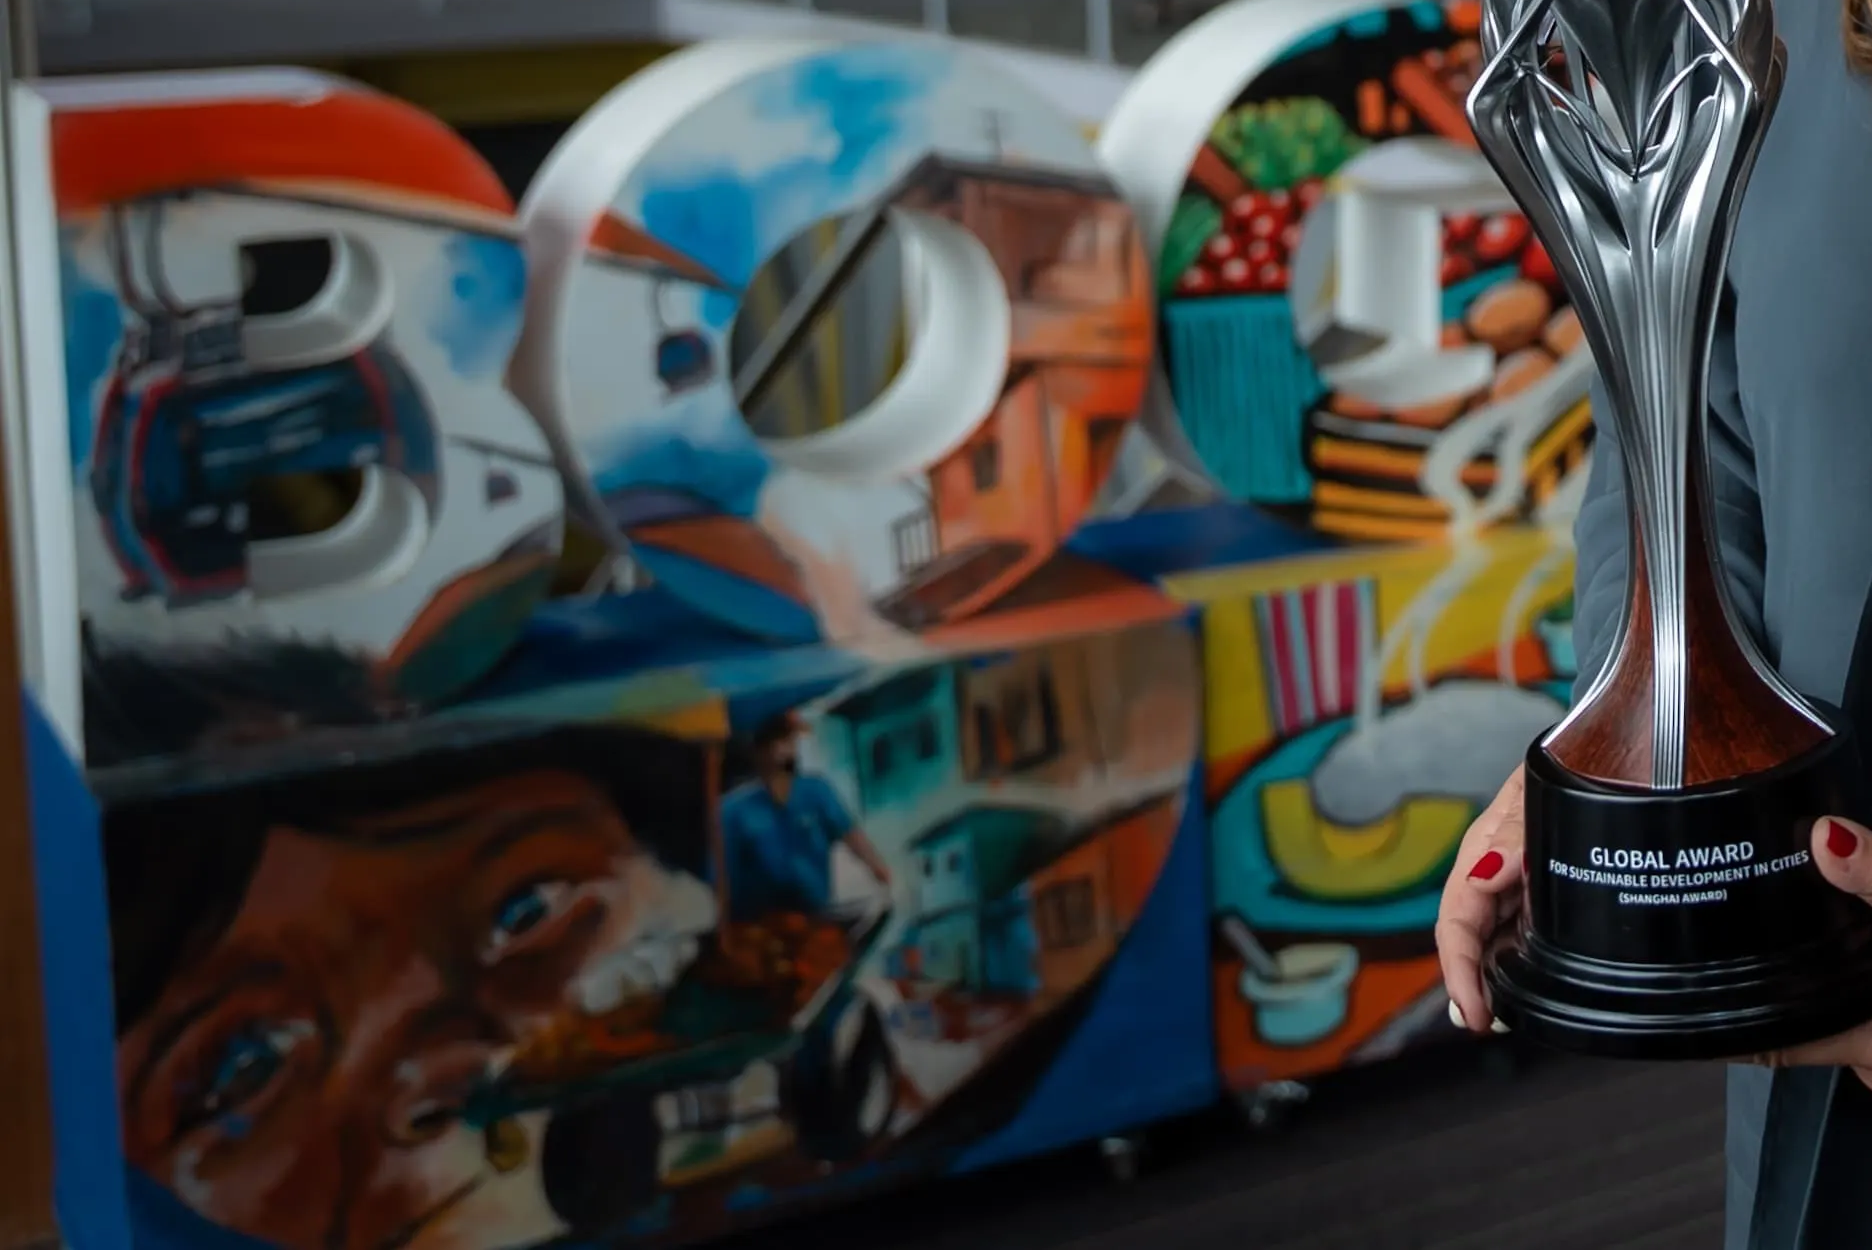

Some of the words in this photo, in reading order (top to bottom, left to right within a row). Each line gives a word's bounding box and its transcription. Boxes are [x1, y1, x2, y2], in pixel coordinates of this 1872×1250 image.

[1549, 859, 1568, 876] FOR
[1568, 866, 1648, 888] SUSTAINABLE
[1651, 865, 1751, 888] DEVELOPMENT
[1754, 862, 1769, 876] IN
[1771, 850, 1809, 872] CITIES
[1590, 846, 1671, 870] GLOBAL
[1676, 842, 1754, 868] AWARD
[1618, 892, 1680, 904] (SHANGHAI
[1683, 890, 1728, 902] AWARD)
